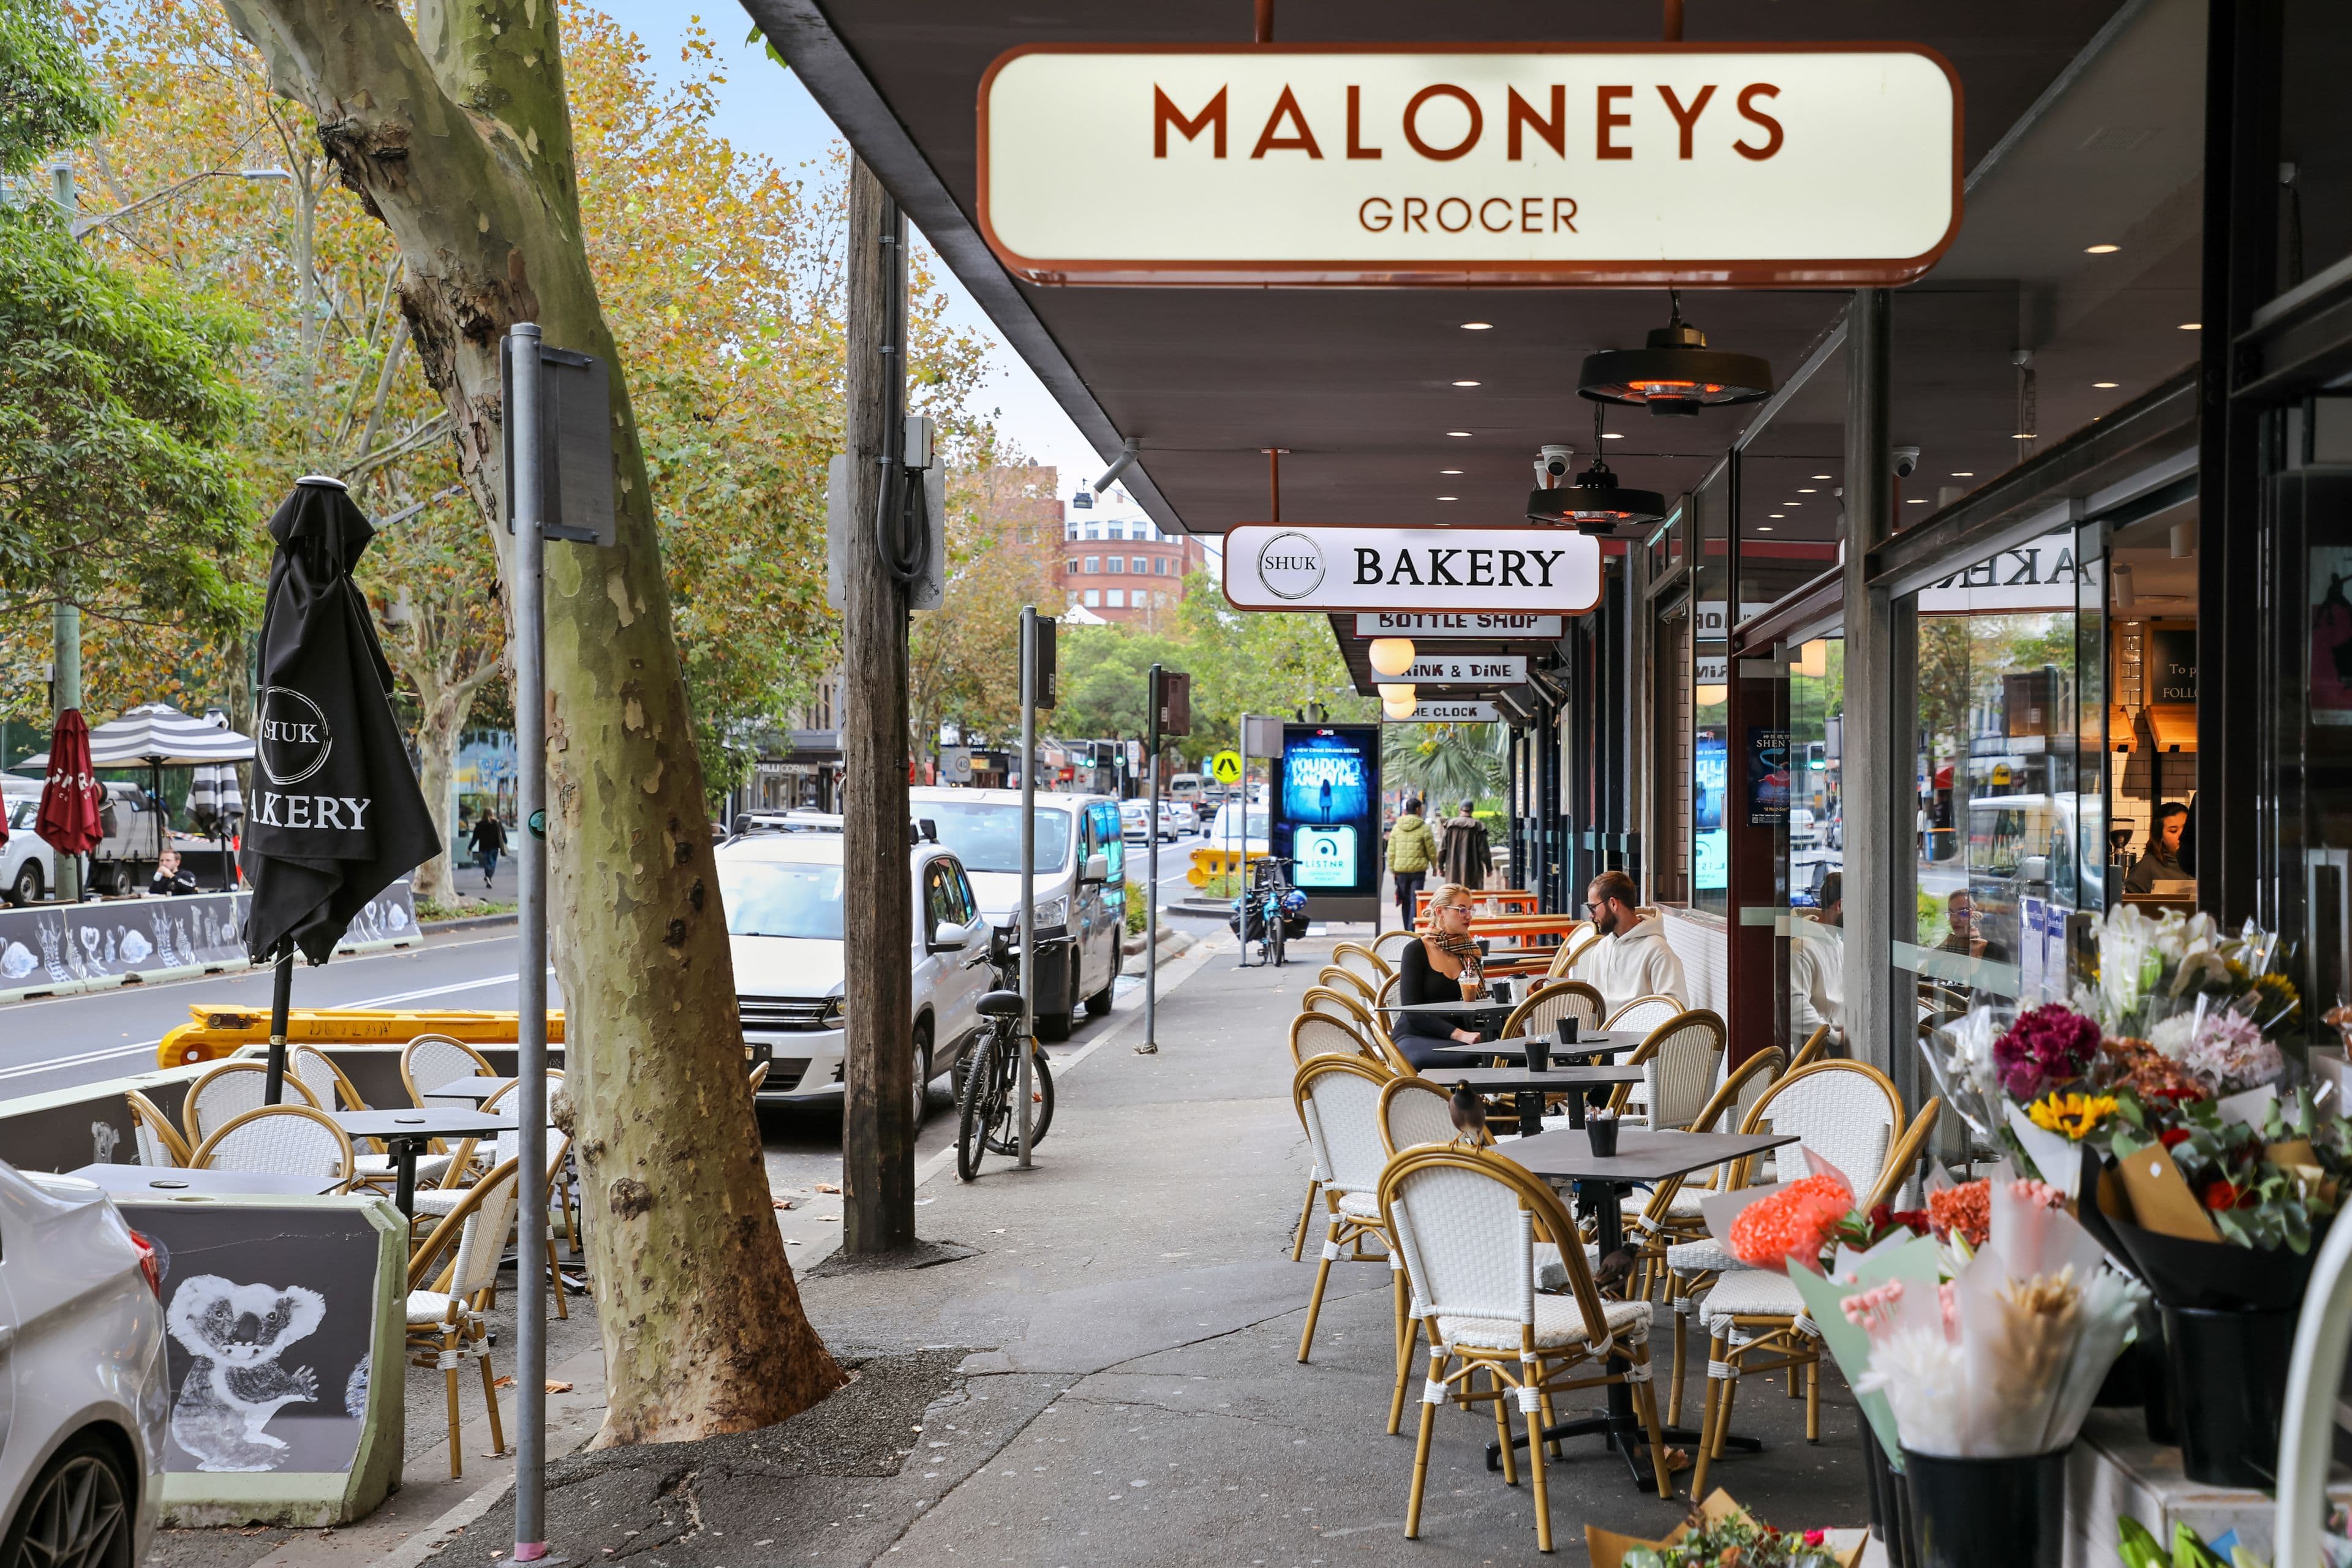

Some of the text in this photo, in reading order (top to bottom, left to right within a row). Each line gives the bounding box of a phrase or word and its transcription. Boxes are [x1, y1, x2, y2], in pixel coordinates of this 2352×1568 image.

[1153, 82, 1784, 162] MALONEYS
[1359, 197, 1578, 233] GROCER
[1264, 556, 1316, 570] SHUK
[1352, 548, 1566, 587] BAKERY
[1379, 614, 1538, 628] BOTTLE SHOP
[1450, 665, 1461, 677] &
[2169, 663, 2186, 674] To
[1412, 707, 1478, 717] HE CLOCK
[264, 718, 320, 744] SHUK
[1292, 772, 1360, 786] KNOW ME
[251, 788, 371, 830] AKERY
